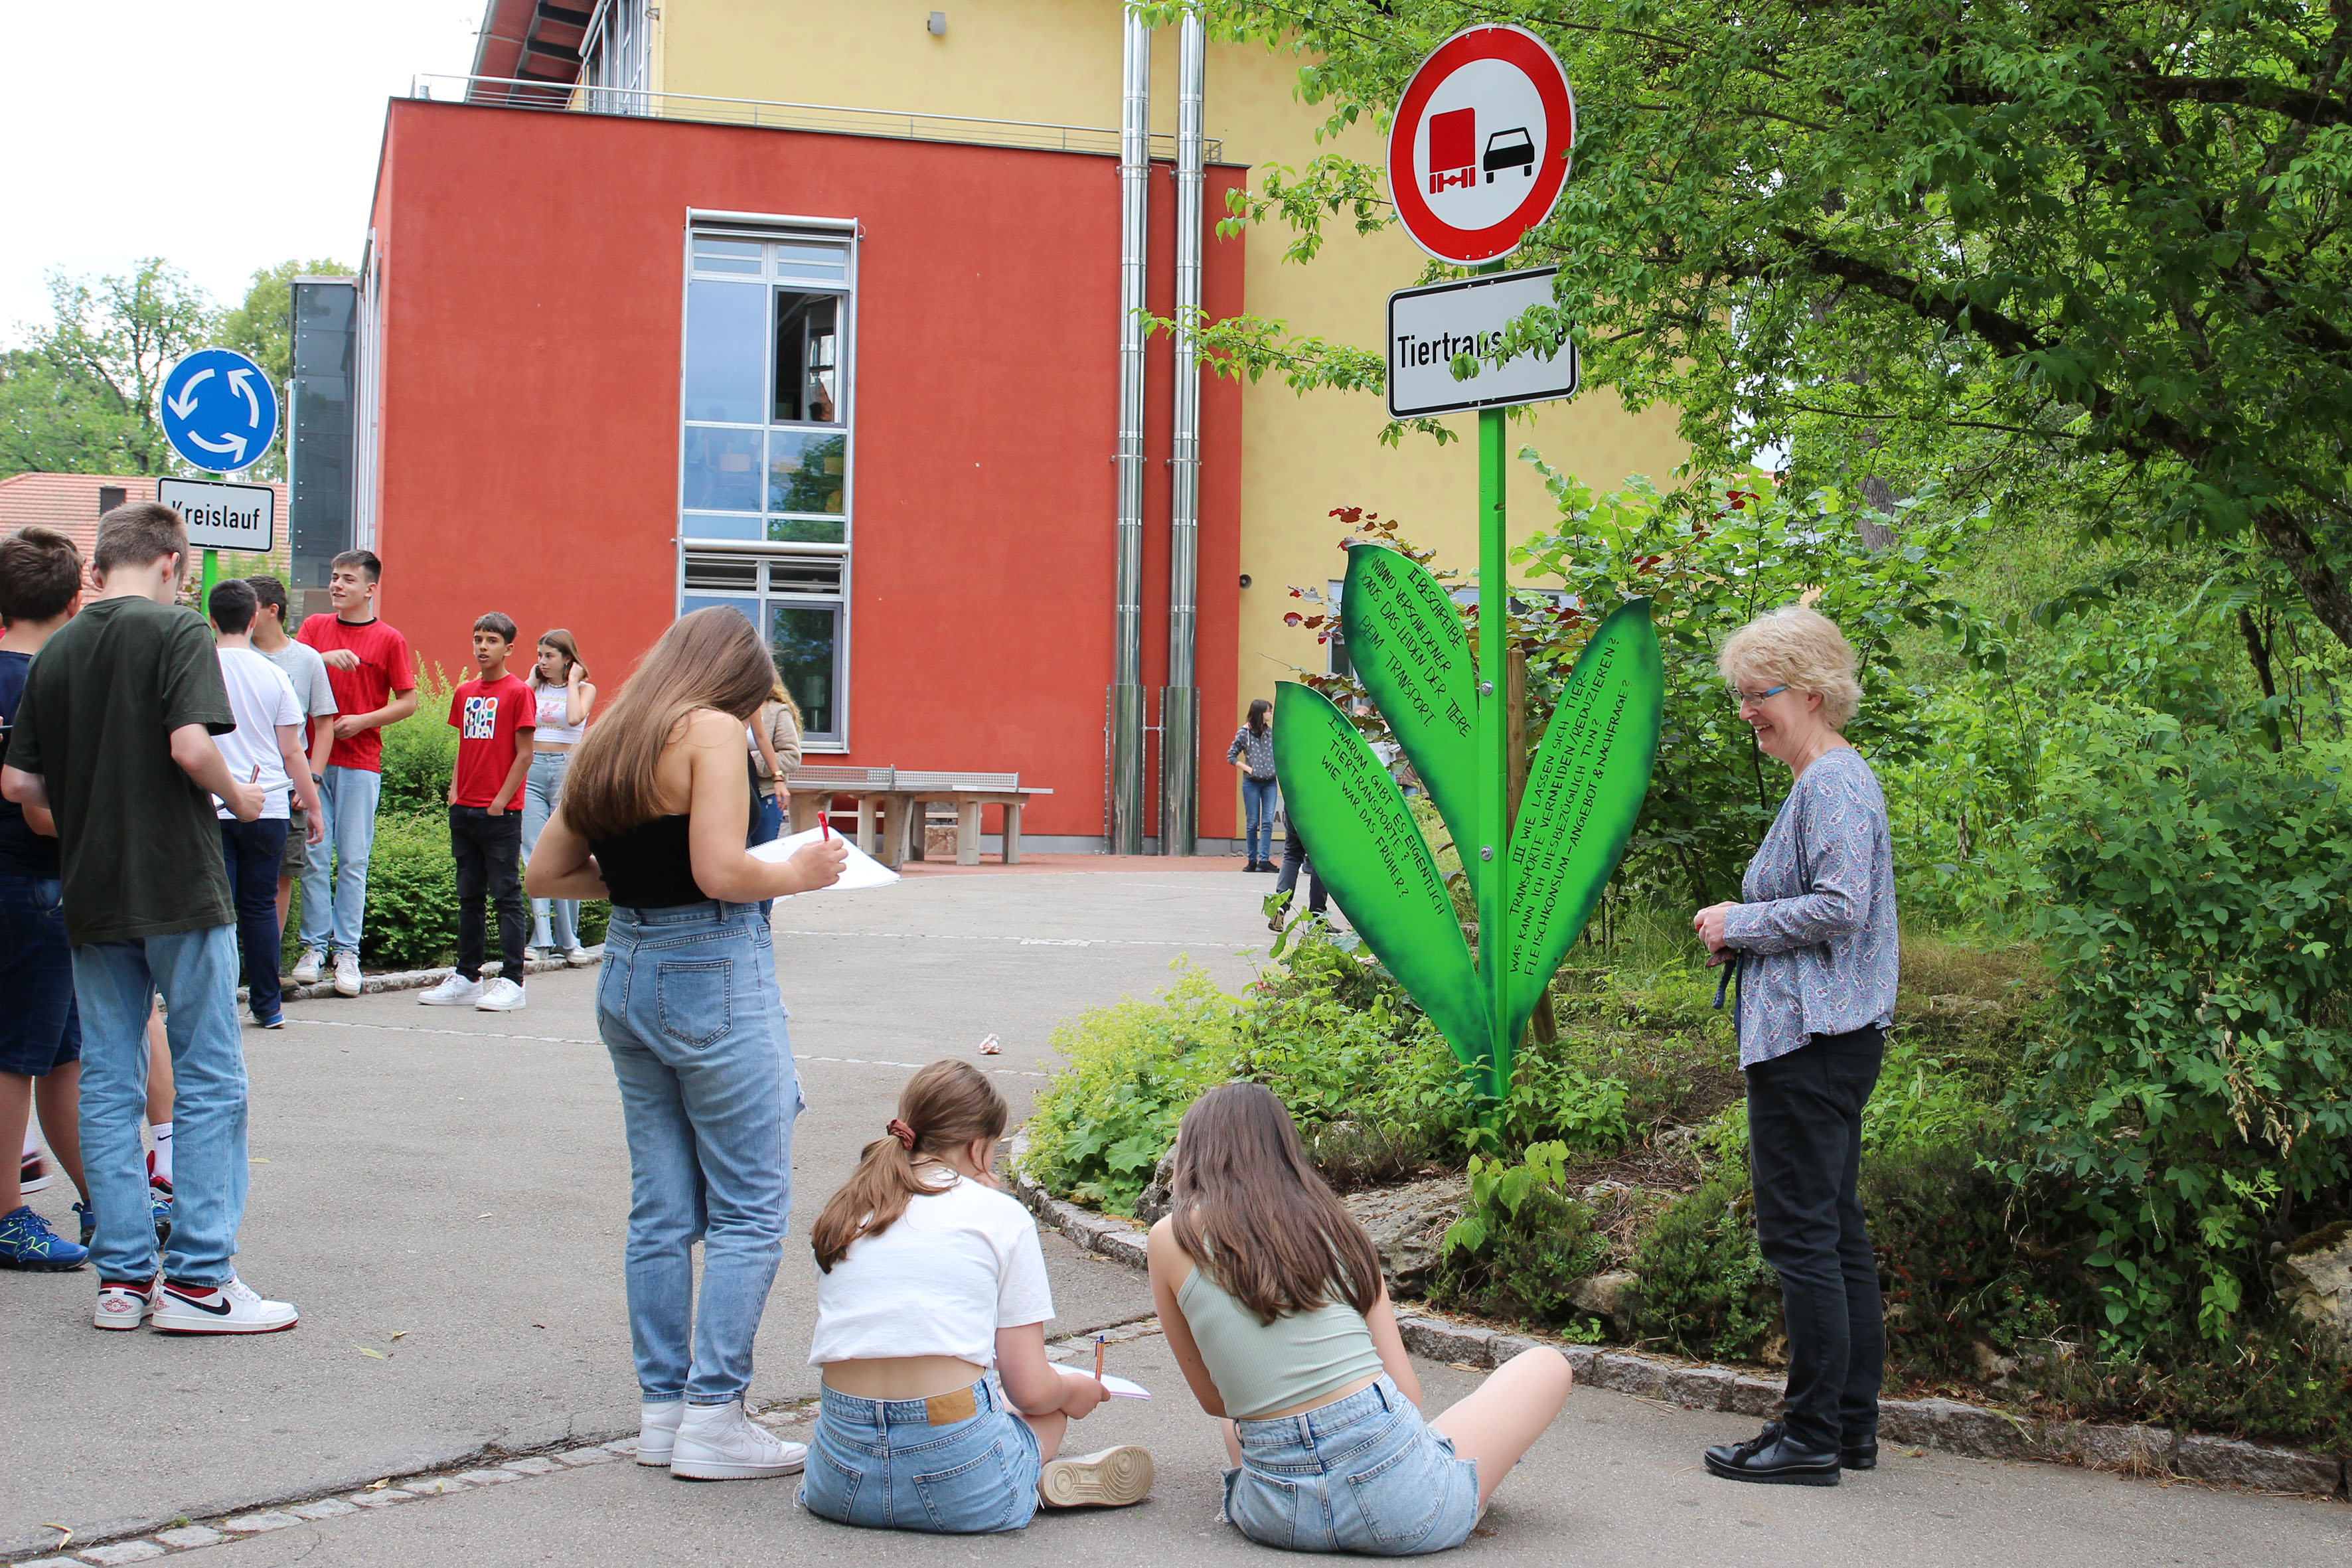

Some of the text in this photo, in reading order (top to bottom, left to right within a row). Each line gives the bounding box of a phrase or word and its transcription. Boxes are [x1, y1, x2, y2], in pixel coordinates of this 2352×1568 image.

[1359, 568, 1472, 738] DOKUS DAS LEIDEN DER TIERE
[1359, 615, 1436, 727] BEIM TRANSPORT.
[1395, 588, 1452, 674] VERSCHIEDENER
[463, 725, 495, 740] LAUREN
[464, 696, 499, 712] POLO
[1321, 755, 1341, 781] WIE
[1342, 781, 1360, 811] WAR
[1359, 809, 1376, 834] DAS
[1520, 817, 1536, 839] WIE
[1531, 755, 1555, 807] LASSEN
[1552, 721, 1569, 749] SICH
[1370, 775, 1393, 805] GIBT
[1393, 813, 1407, 833] ES
[1405, 834, 1445, 915] EIGENTLICH
[1509, 834, 1545, 915] TRANSPORTE
[1510, 945, 1522, 973] WAS
[1517, 905, 1535, 939] KANN
[1531, 877, 1545, 896] ICH
[1541, 765, 1586, 870] DIESBEZÜGLICH
[1524, 856, 1570, 976] FLEISCHKONSUM
[1570, 780, 1598, 847] ANGEBOT
